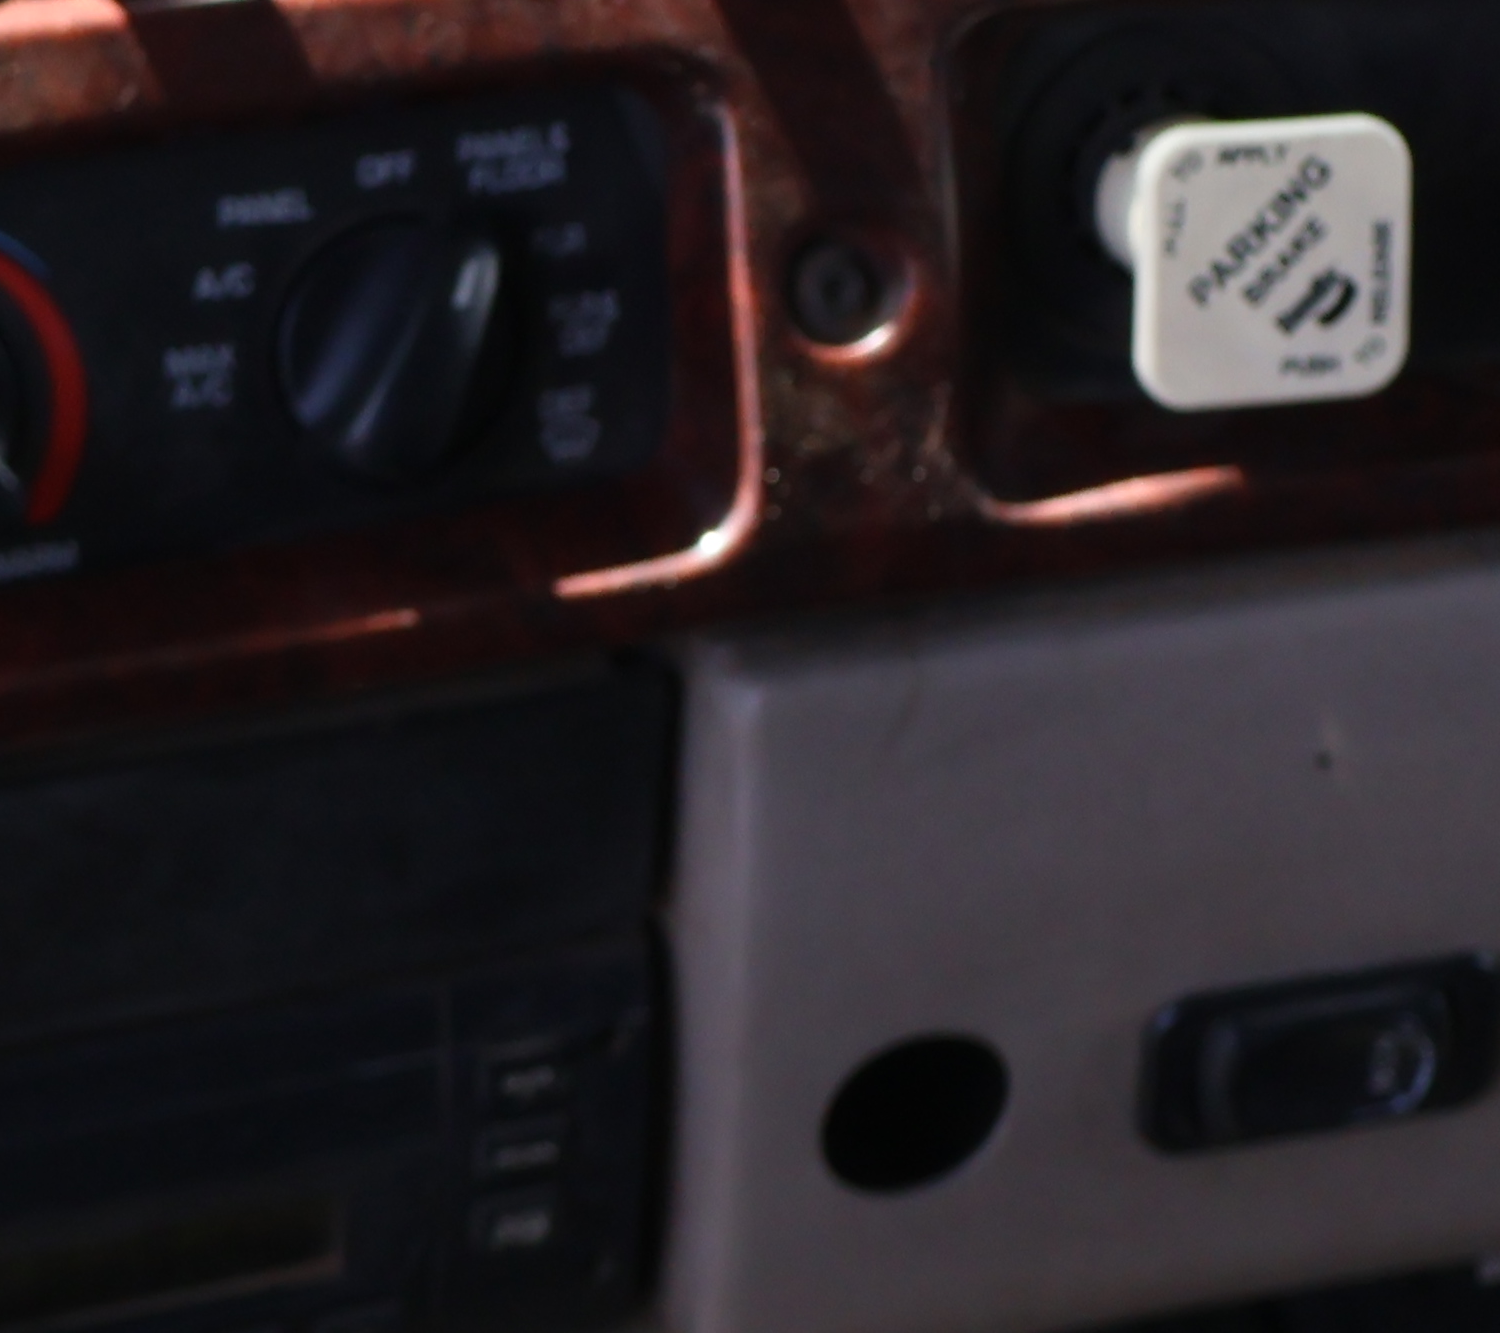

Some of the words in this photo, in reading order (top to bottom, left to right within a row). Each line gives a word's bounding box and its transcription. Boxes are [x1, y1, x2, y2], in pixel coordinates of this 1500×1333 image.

[356, 149, 417, 189] OFF
[216, 188, 315, 227] PANEL
[1189, 153, 1331, 307] PARKING
[192, 261, 255, 300] A/C
